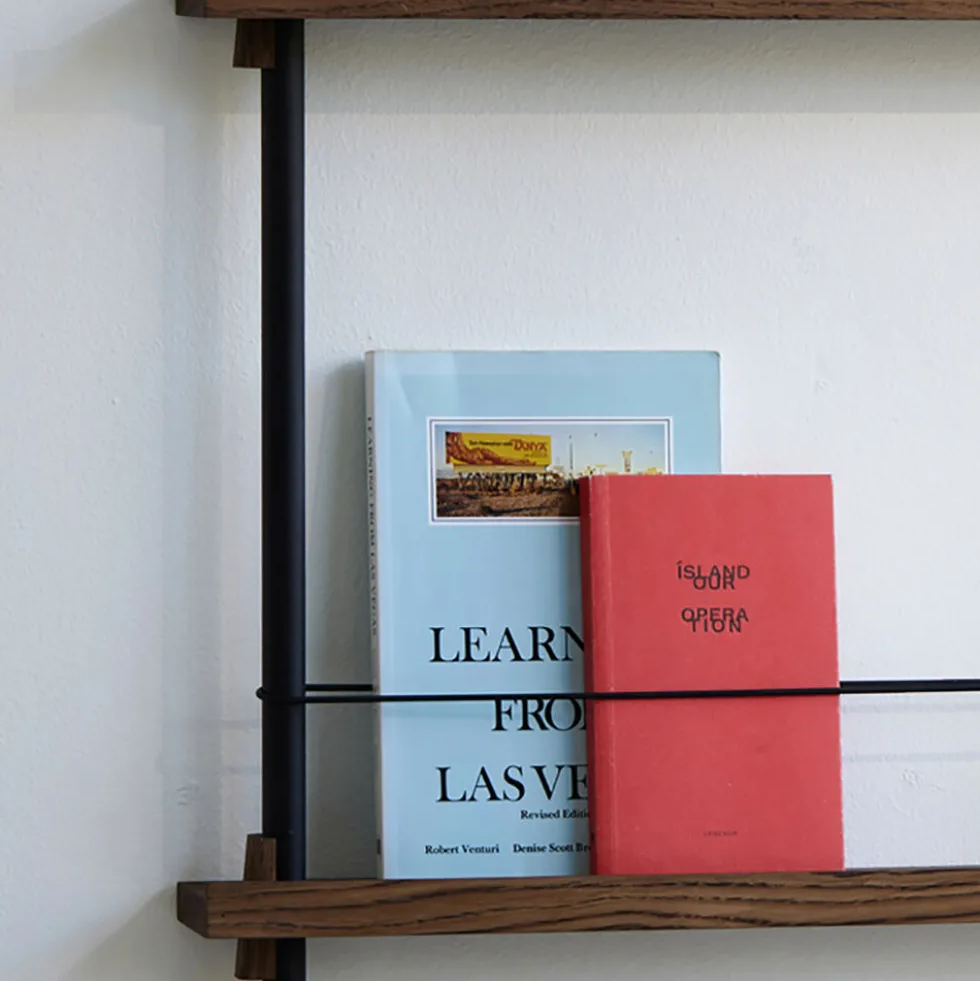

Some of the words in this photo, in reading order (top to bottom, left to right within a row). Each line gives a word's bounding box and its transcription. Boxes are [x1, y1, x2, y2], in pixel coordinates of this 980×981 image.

[676, 560, 750, 579] ÍSLAND
[693, 575, 735, 590] OUR
[681, 607, 749, 622] OPERA
[692, 618, 742, 633] TION
[491, 698, 587, 731] FRO
[435, 764, 525, 802] LAS
[520, 809, 560, 819] Revised
[425, 844, 459, 854] Robert
[462, 843, 500, 854] Venturi
[513, 843, 547, 853] Denise
[549, 842, 573, 853] Scott
